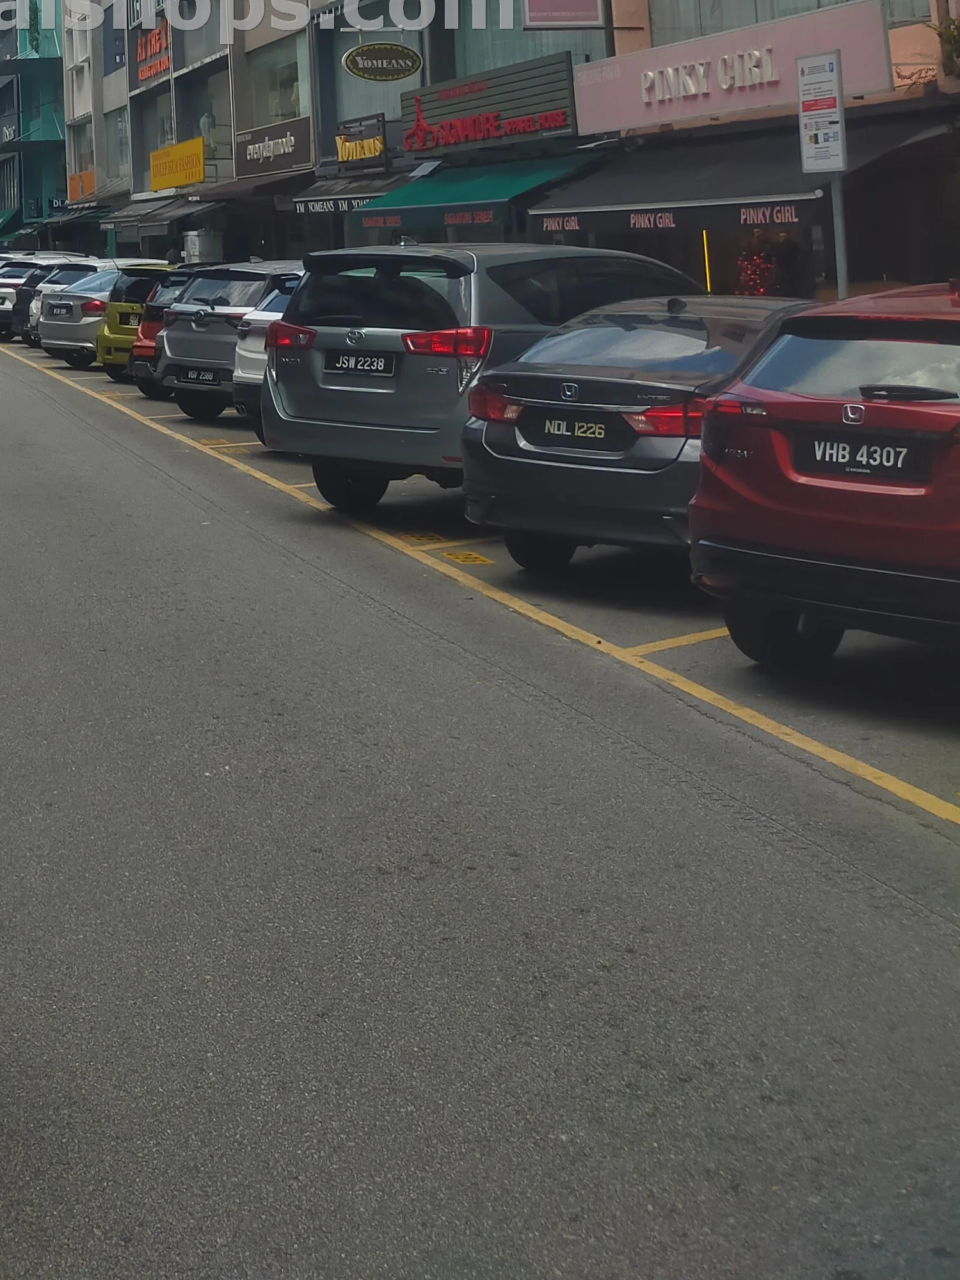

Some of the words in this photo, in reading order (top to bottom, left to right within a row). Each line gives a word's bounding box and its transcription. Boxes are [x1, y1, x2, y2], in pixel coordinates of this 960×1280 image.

[642, 61, 711, 103] PINKY
[717, 46, 781, 90] GIRL
[438, 110, 502, 146] SIGNATURE
[308, 200, 334, 212] YOMEANS
[741, 207, 772, 224] PINKY
[773, 206, 799, 222] GIRL
[543, 219, 563, 230] PINKY
[564, 217, 580, 229] GIRL
[630, 214, 655, 228] PINKY
[657, 213, 676, 227] GIRL
[336, 356, 355, 368] JSW
[357, 357, 385, 370] 2238
[545, 420, 571, 435] NDL
[574, 422, 605, 438] 1226
[814, 441, 850, 463] VHB
[856, 444, 908, 468] 4307
